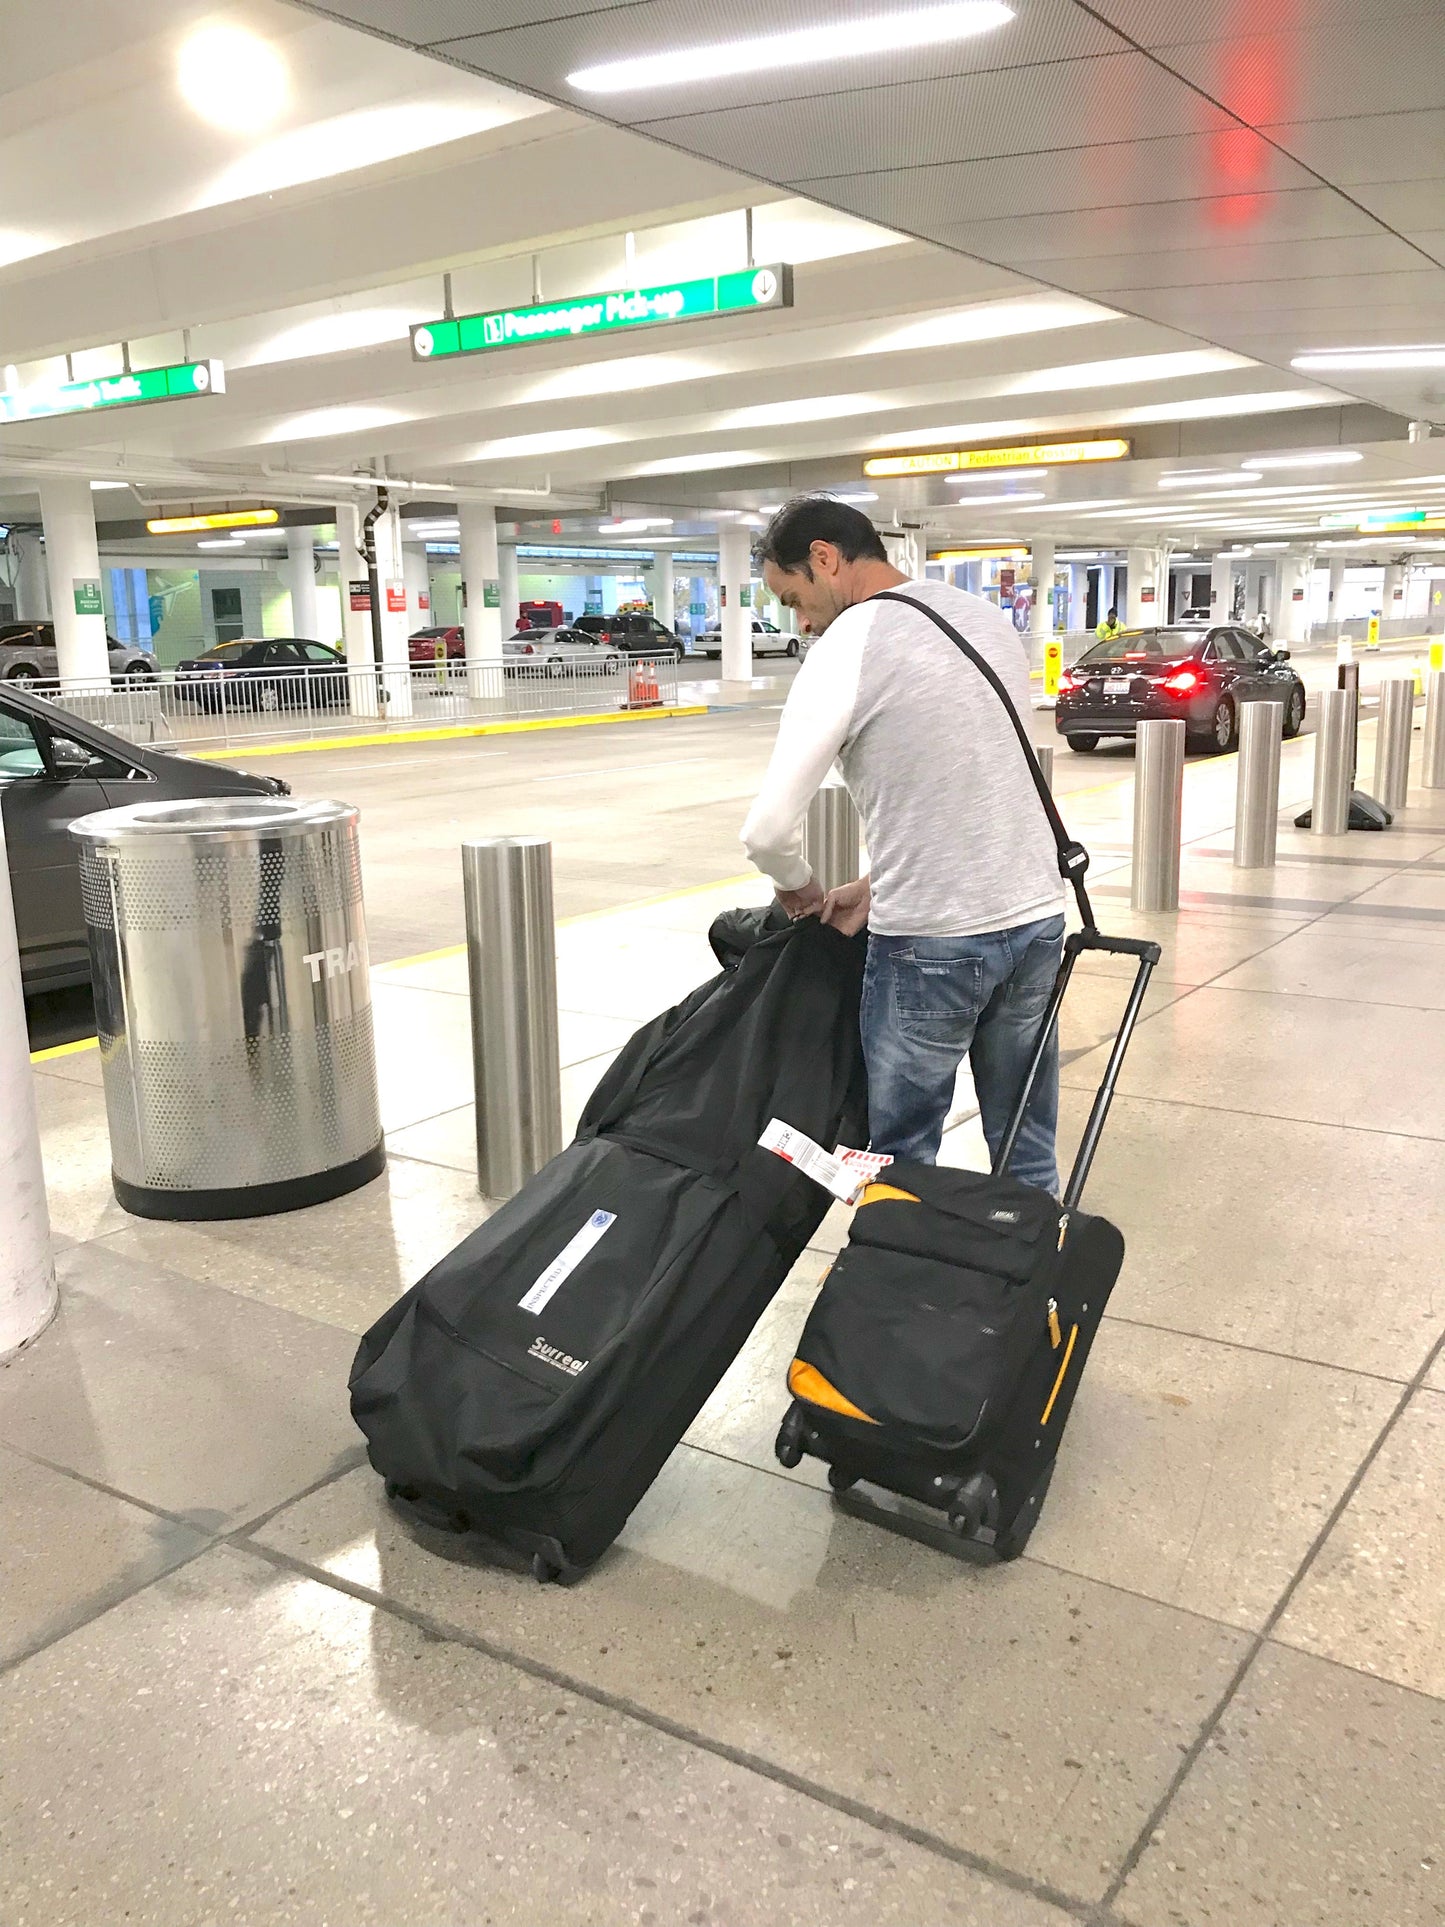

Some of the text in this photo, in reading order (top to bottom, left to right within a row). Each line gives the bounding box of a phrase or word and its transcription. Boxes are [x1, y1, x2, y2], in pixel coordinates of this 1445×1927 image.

[606, 290, 684, 322] Pick-up
[903, 455, 952, 468] CAUTION
[969, 446, 1084, 465] Pedestrian Crossing
[531, 1336, 589, 1372] Surreal
